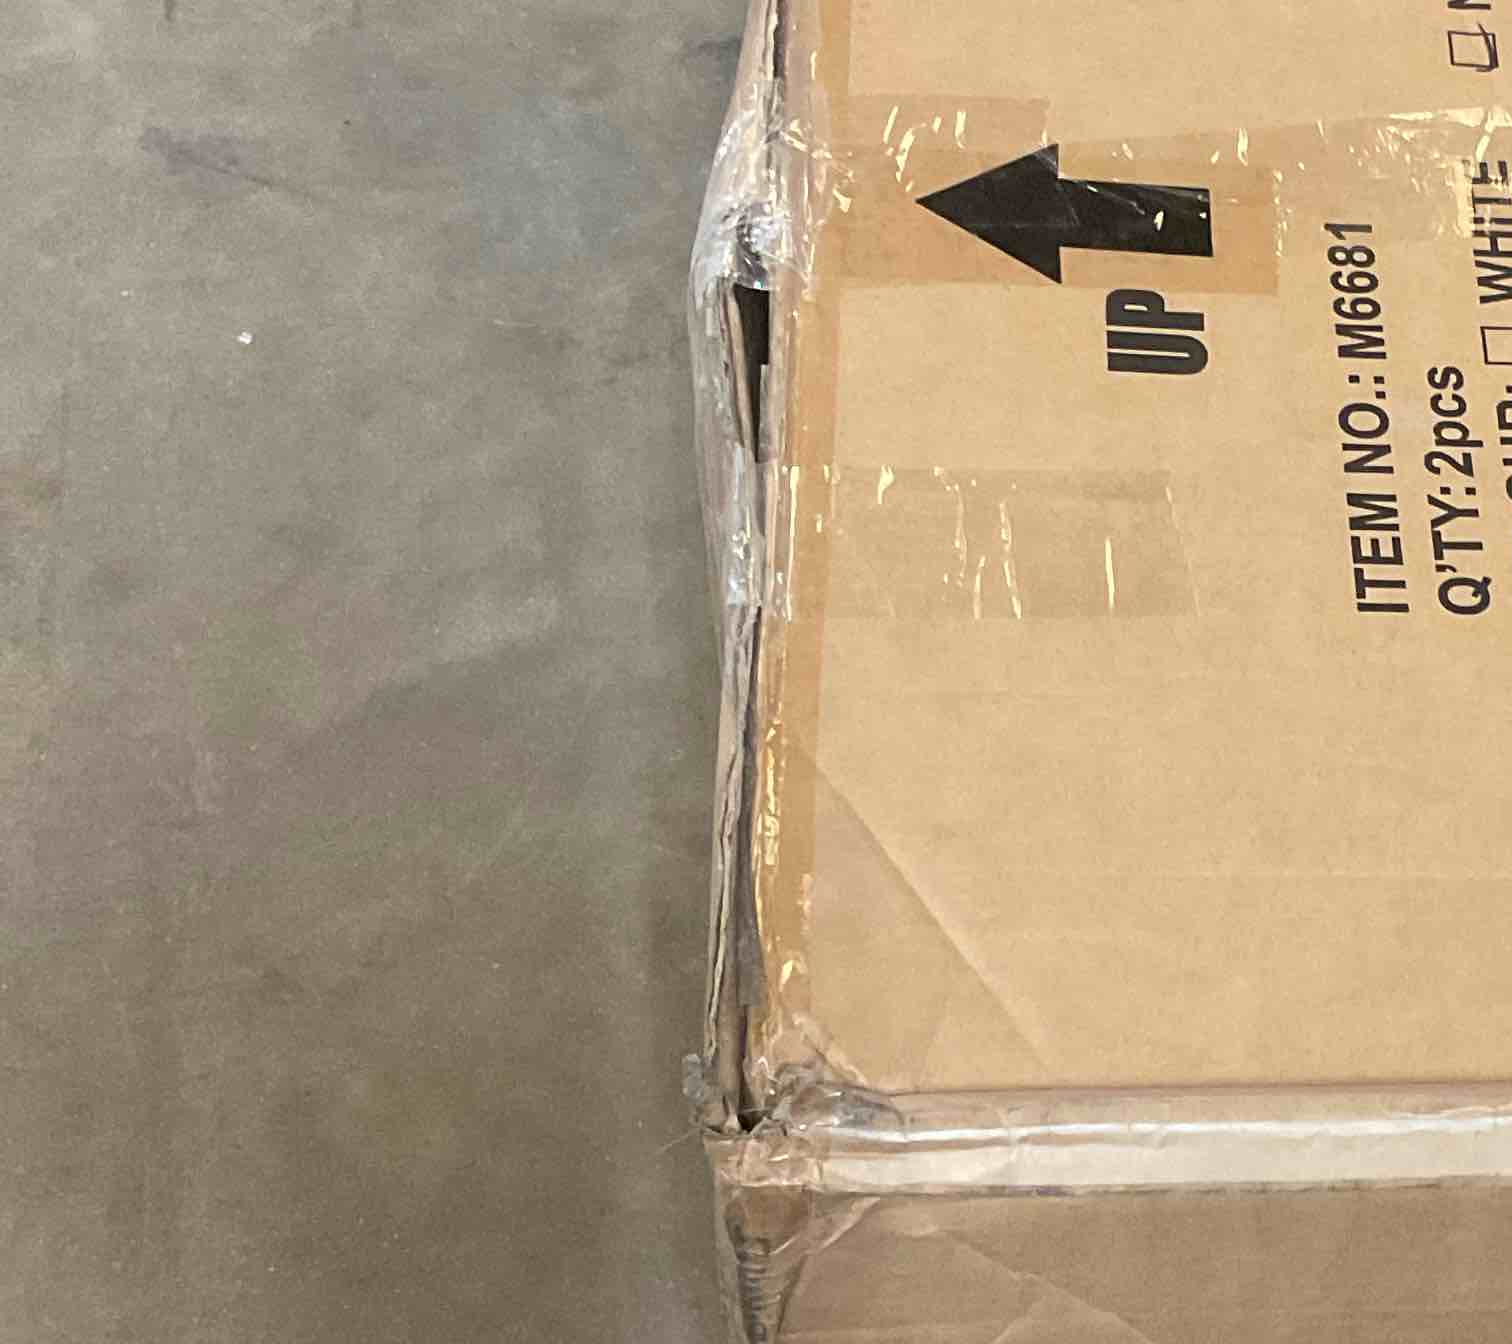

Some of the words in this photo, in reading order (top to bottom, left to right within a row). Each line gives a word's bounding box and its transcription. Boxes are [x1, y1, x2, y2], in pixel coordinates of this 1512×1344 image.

[1106, 289, 1208, 375] UP
[1323, 221, 1388, 361] M6681
[1346, 491, 1410, 614] ITEM
